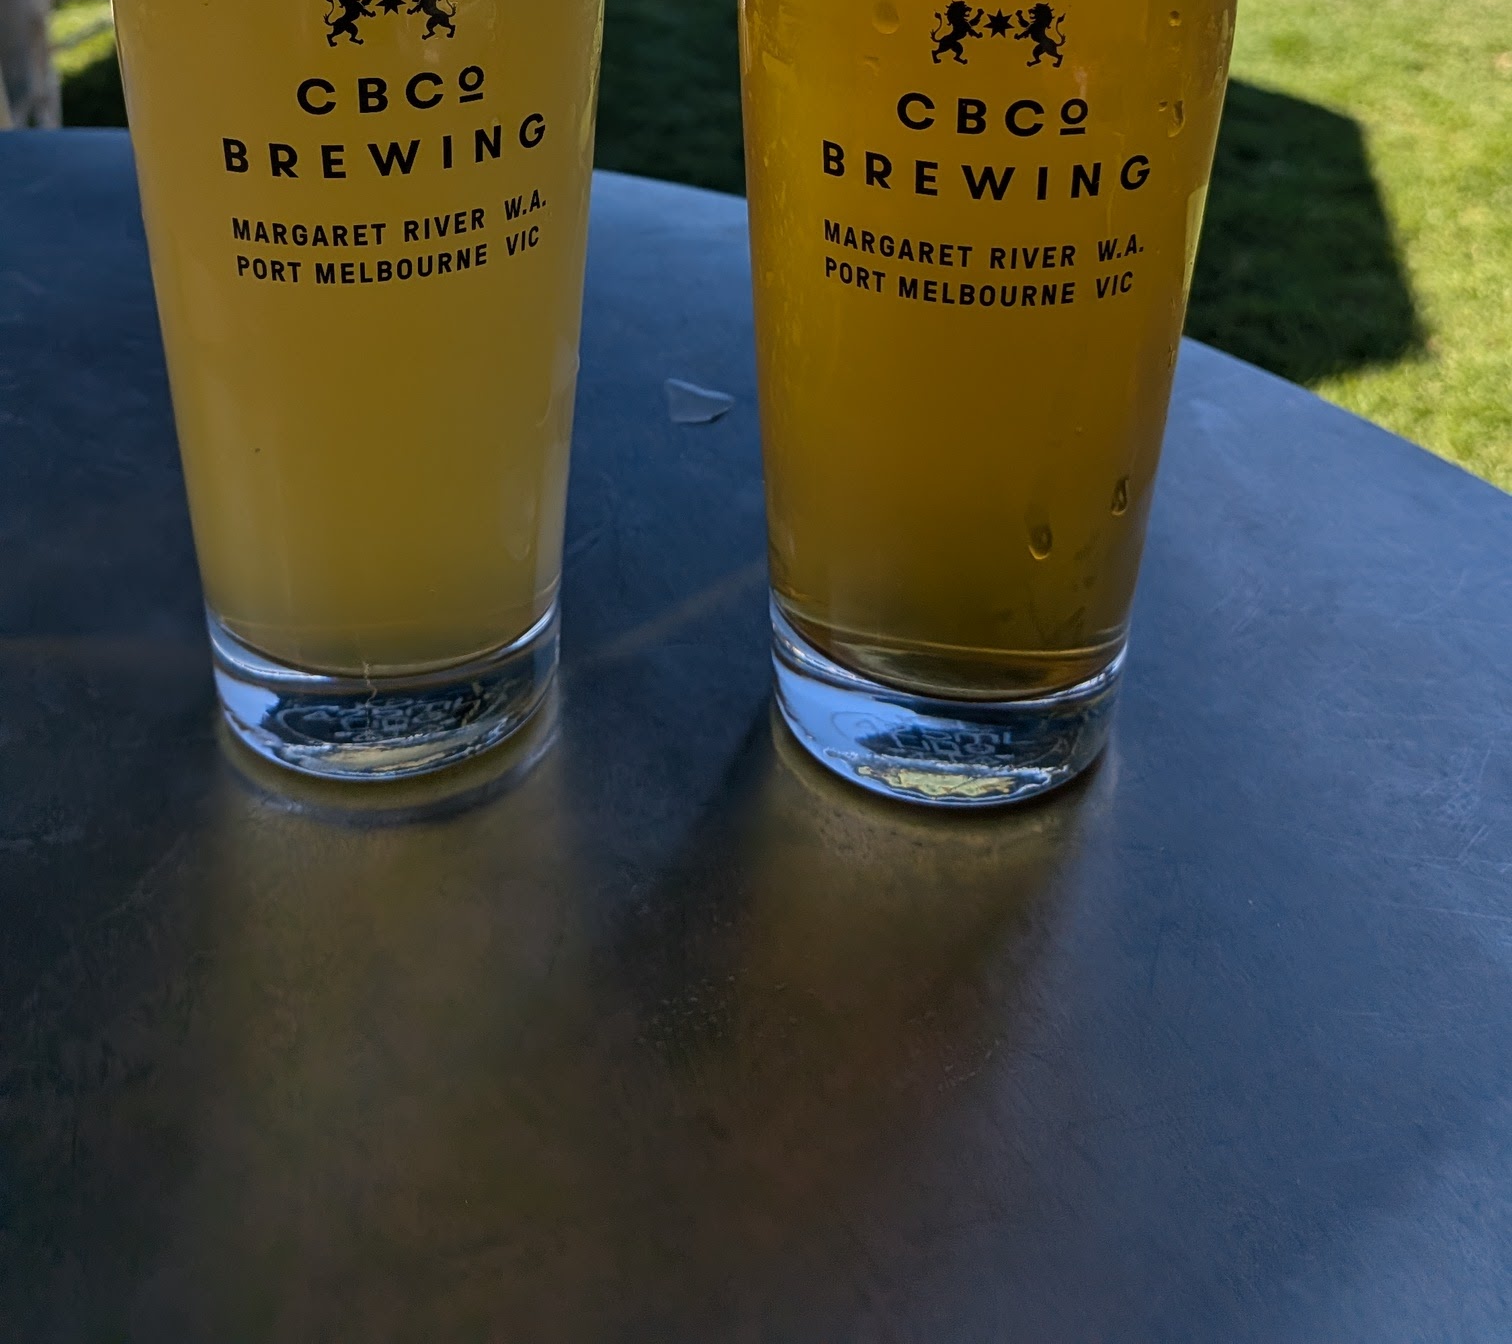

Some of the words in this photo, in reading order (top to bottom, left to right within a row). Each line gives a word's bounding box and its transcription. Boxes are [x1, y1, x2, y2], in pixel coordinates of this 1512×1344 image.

[222, 113, 546, 179] BREWING
[822, 139, 1150, 201] BREWING
[232, 217, 386, 247] MARGARET
[404, 208, 485, 243] RIVER
[504, 189, 547, 221] W.A.
[823, 219, 973, 268] MARGARET
[989, 245, 1076, 270] RIVER
[1098, 234, 1144, 262] W.A.
[237, 255, 301, 283] PORT
[315, 243, 487, 284] MELBOURNE
[506, 226, 540, 256] VIC
[825, 256, 885, 293] PORT
[898, 276, 1075, 307] MELBOURNE
[1095, 271, 1134, 299] VIC
